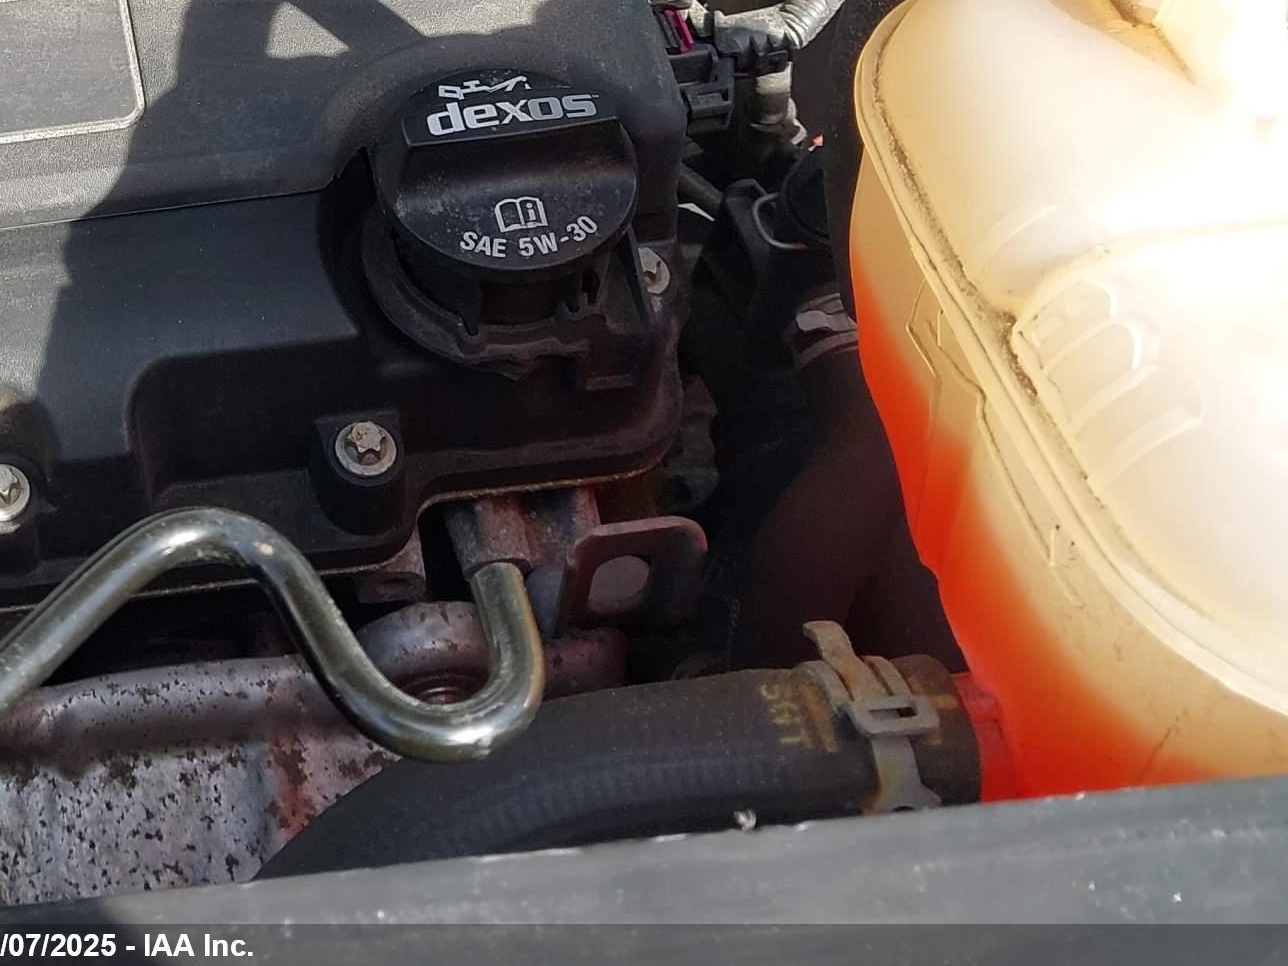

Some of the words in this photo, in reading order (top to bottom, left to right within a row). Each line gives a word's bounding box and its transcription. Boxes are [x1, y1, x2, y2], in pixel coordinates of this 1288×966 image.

[426, 94, 597, 136] dexos
[460, 231, 506, 258] SAE
[519, 216, 598, 257] 5W-30
